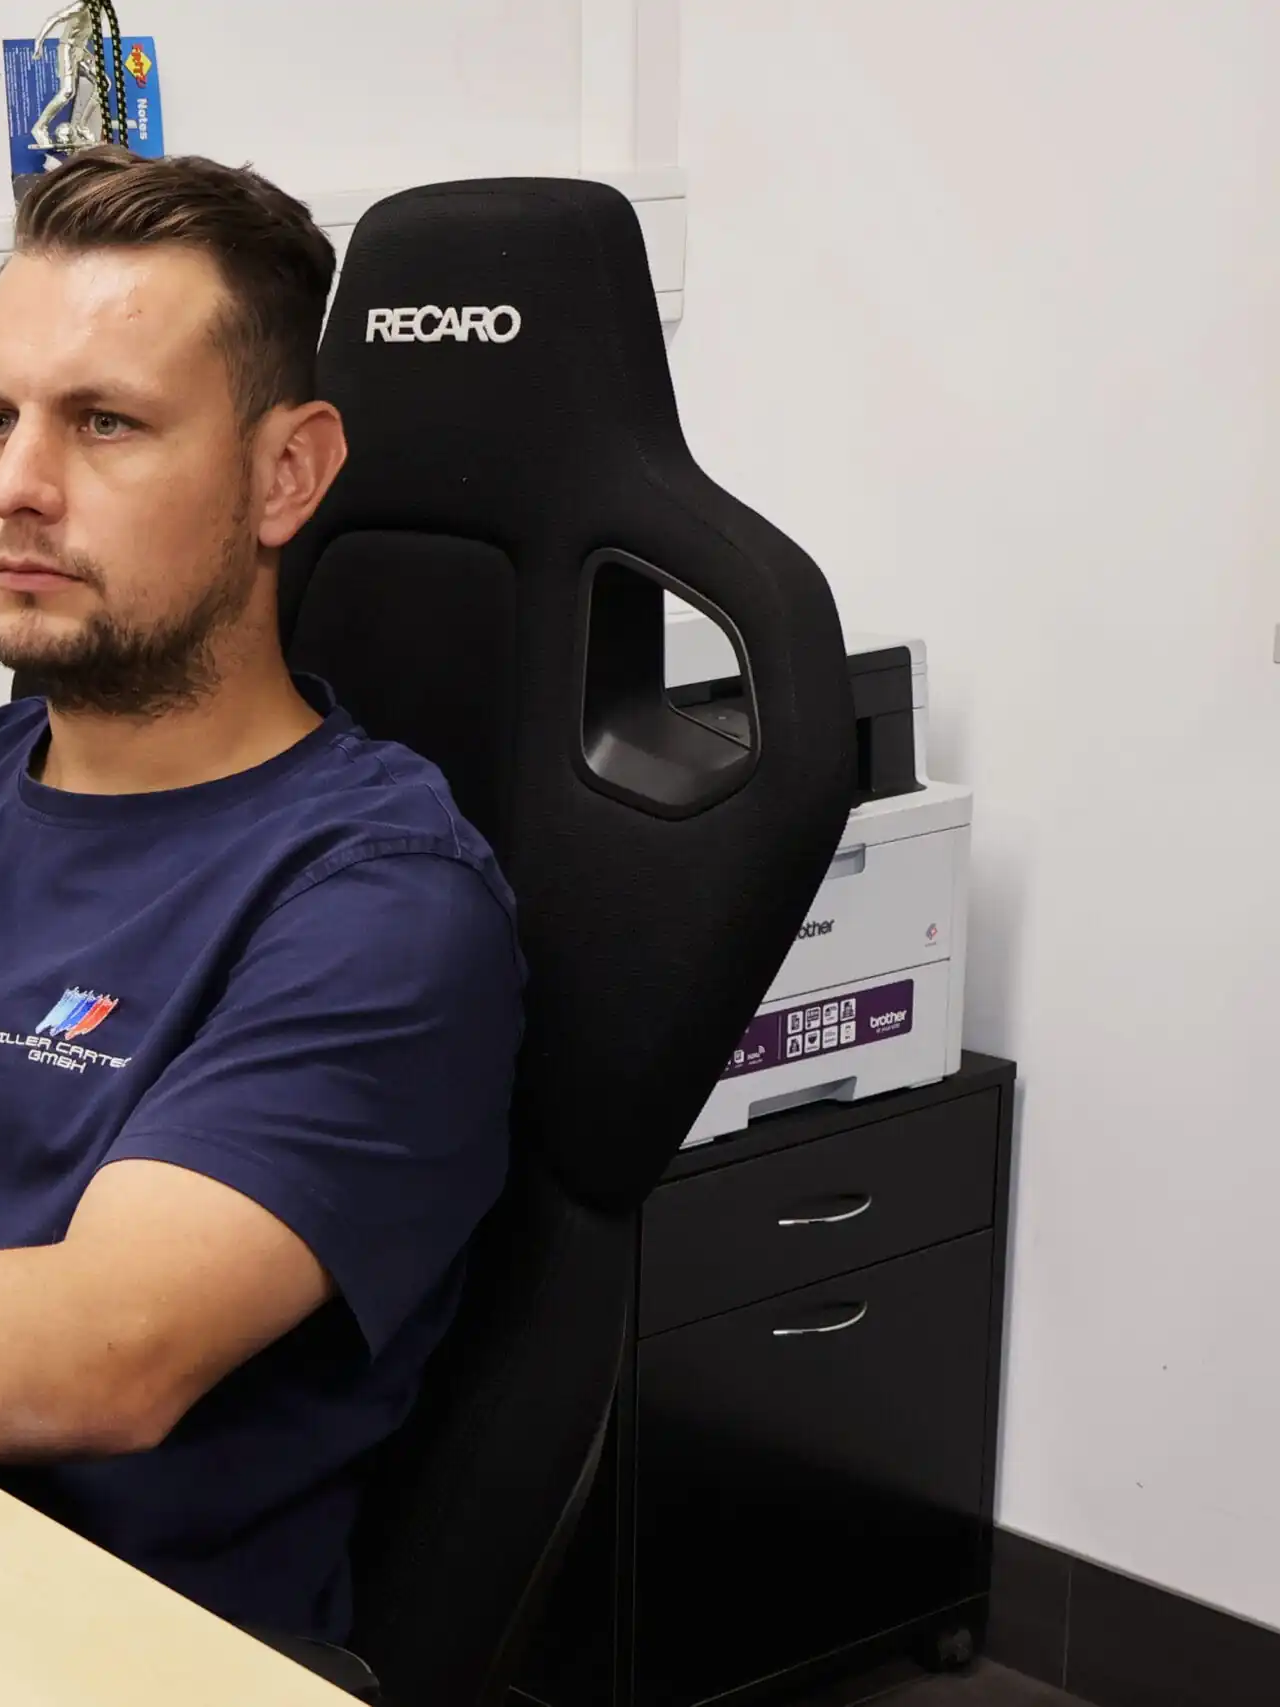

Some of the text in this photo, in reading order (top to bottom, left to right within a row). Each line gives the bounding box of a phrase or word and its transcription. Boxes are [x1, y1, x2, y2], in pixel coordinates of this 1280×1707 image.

[136, 98, 148, 140] Notes
[366, 305, 521, 343] RECARO
[798, 919, 835, 940] other
[870, 1010, 907, 1028] brother
[28, 1049, 87, 1074] GMBH
